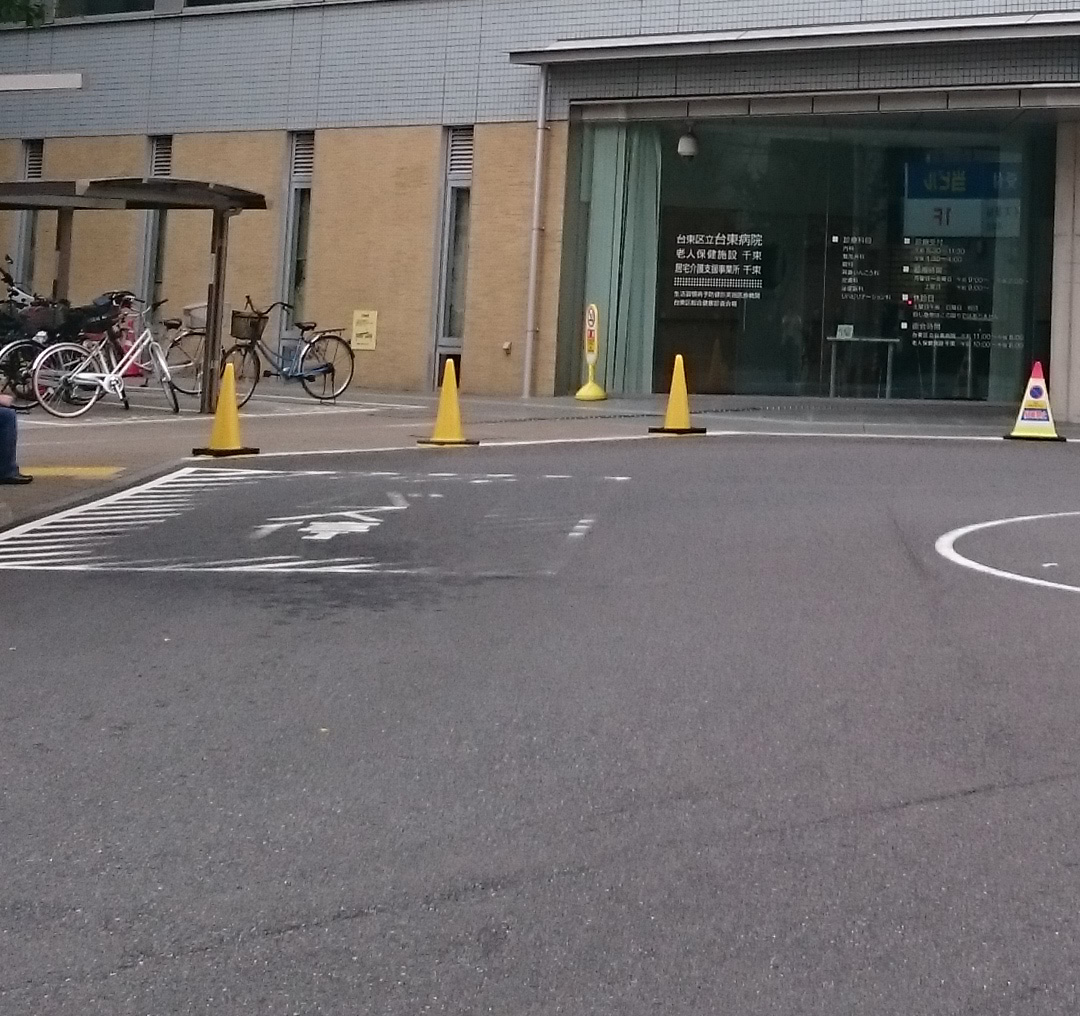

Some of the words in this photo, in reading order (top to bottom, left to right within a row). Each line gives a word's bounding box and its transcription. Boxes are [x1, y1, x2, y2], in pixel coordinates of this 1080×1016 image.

[676, 232, 763, 246] 台東区立台東病院
[676, 248, 737, 260] 老人保健施設
